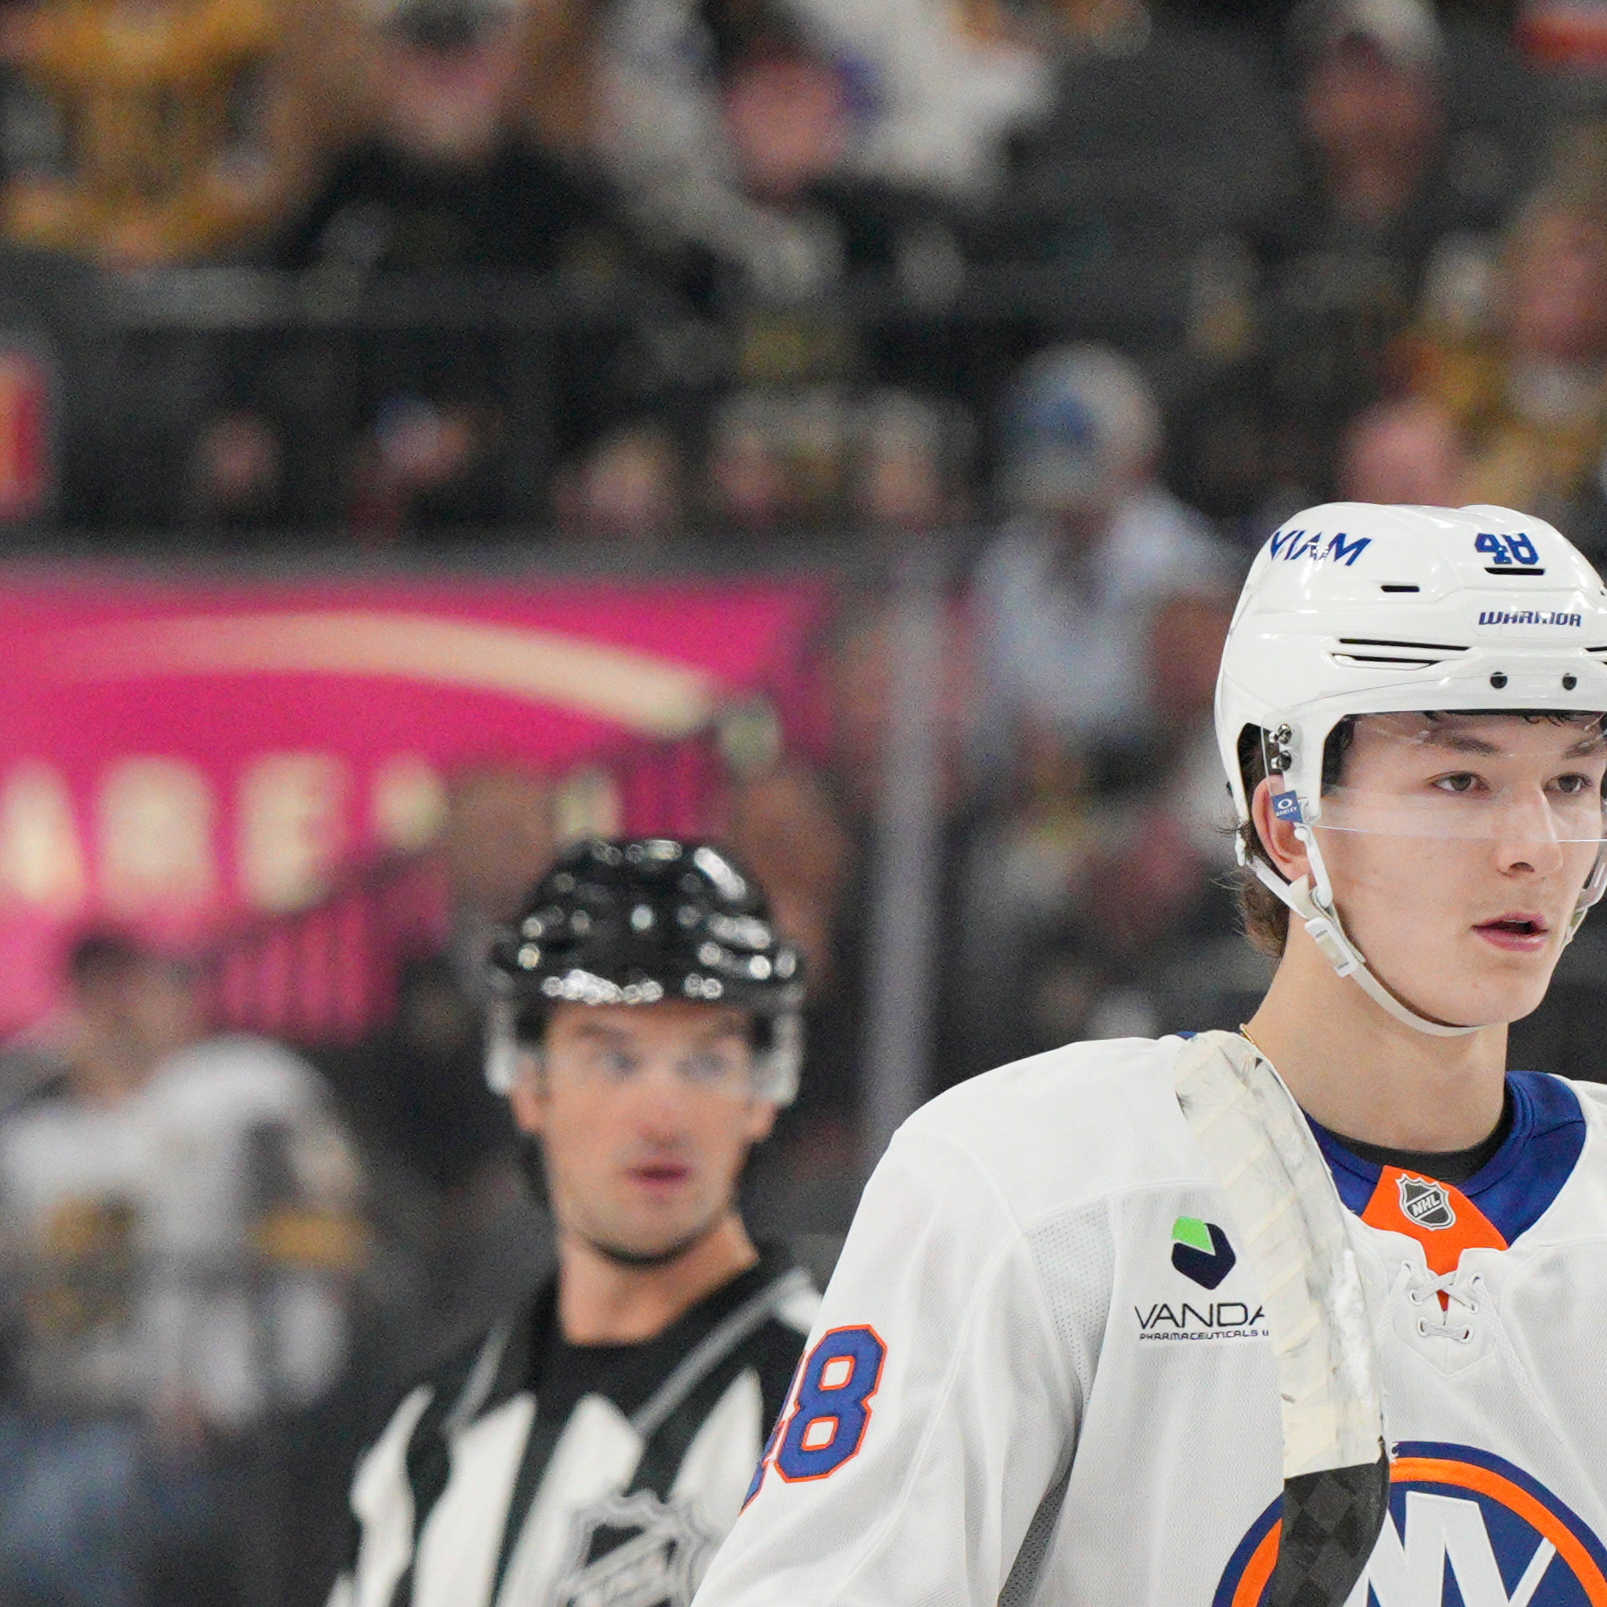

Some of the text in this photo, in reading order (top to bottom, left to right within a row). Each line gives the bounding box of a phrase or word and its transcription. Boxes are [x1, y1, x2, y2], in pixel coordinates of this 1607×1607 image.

[1270, 529, 1373, 567] VIAM
[1474, 533, 1540, 565] 48
[1411, 1194, 1440, 1217] NHL
[1139, 1330, 1258, 1340] PHARMACEUTICALS
